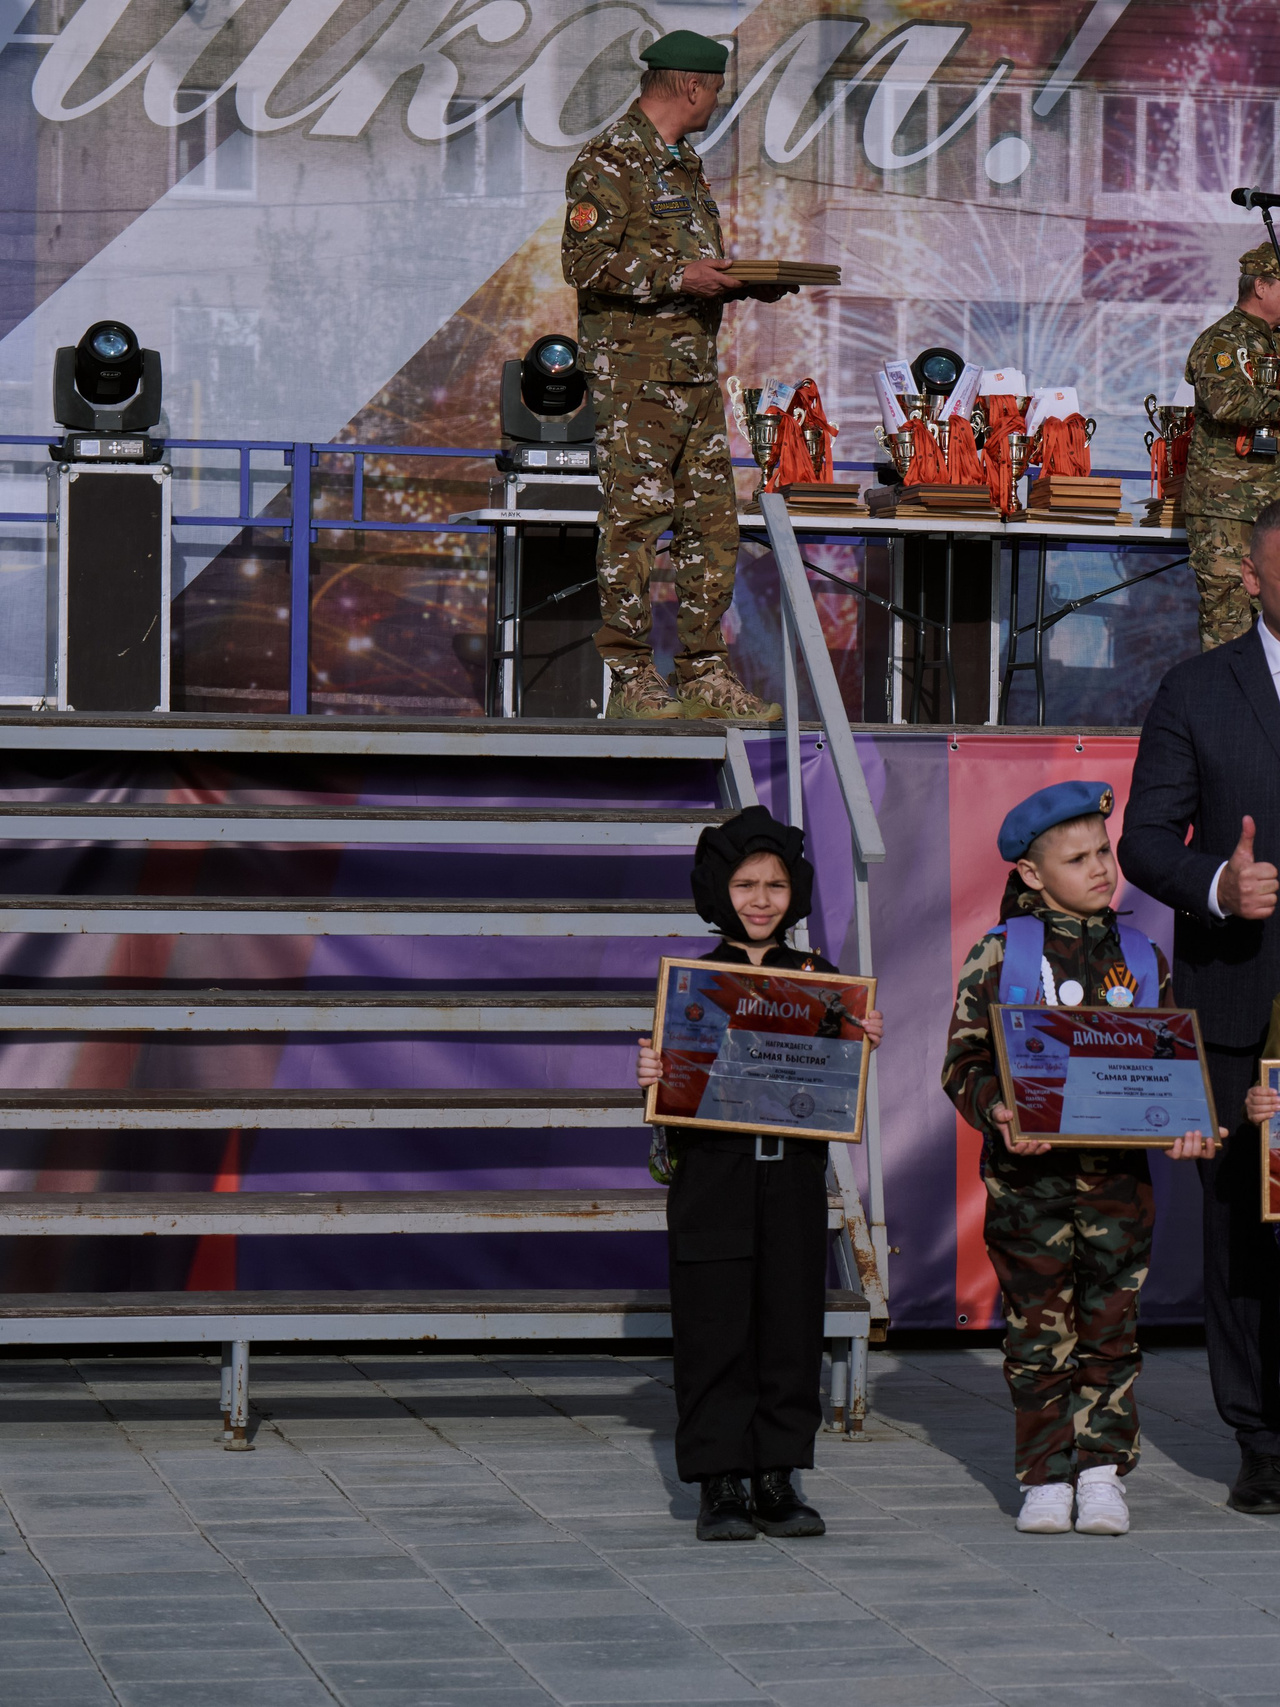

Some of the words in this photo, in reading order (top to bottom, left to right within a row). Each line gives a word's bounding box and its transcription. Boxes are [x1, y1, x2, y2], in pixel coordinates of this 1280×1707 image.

[735, 998, 811, 1020] ДИПЛОМ
[765, 1040, 813, 1051] НАГРАЖДАЕТСЯ
[1072, 1030, 1144, 1046] ДИПЛОМ
